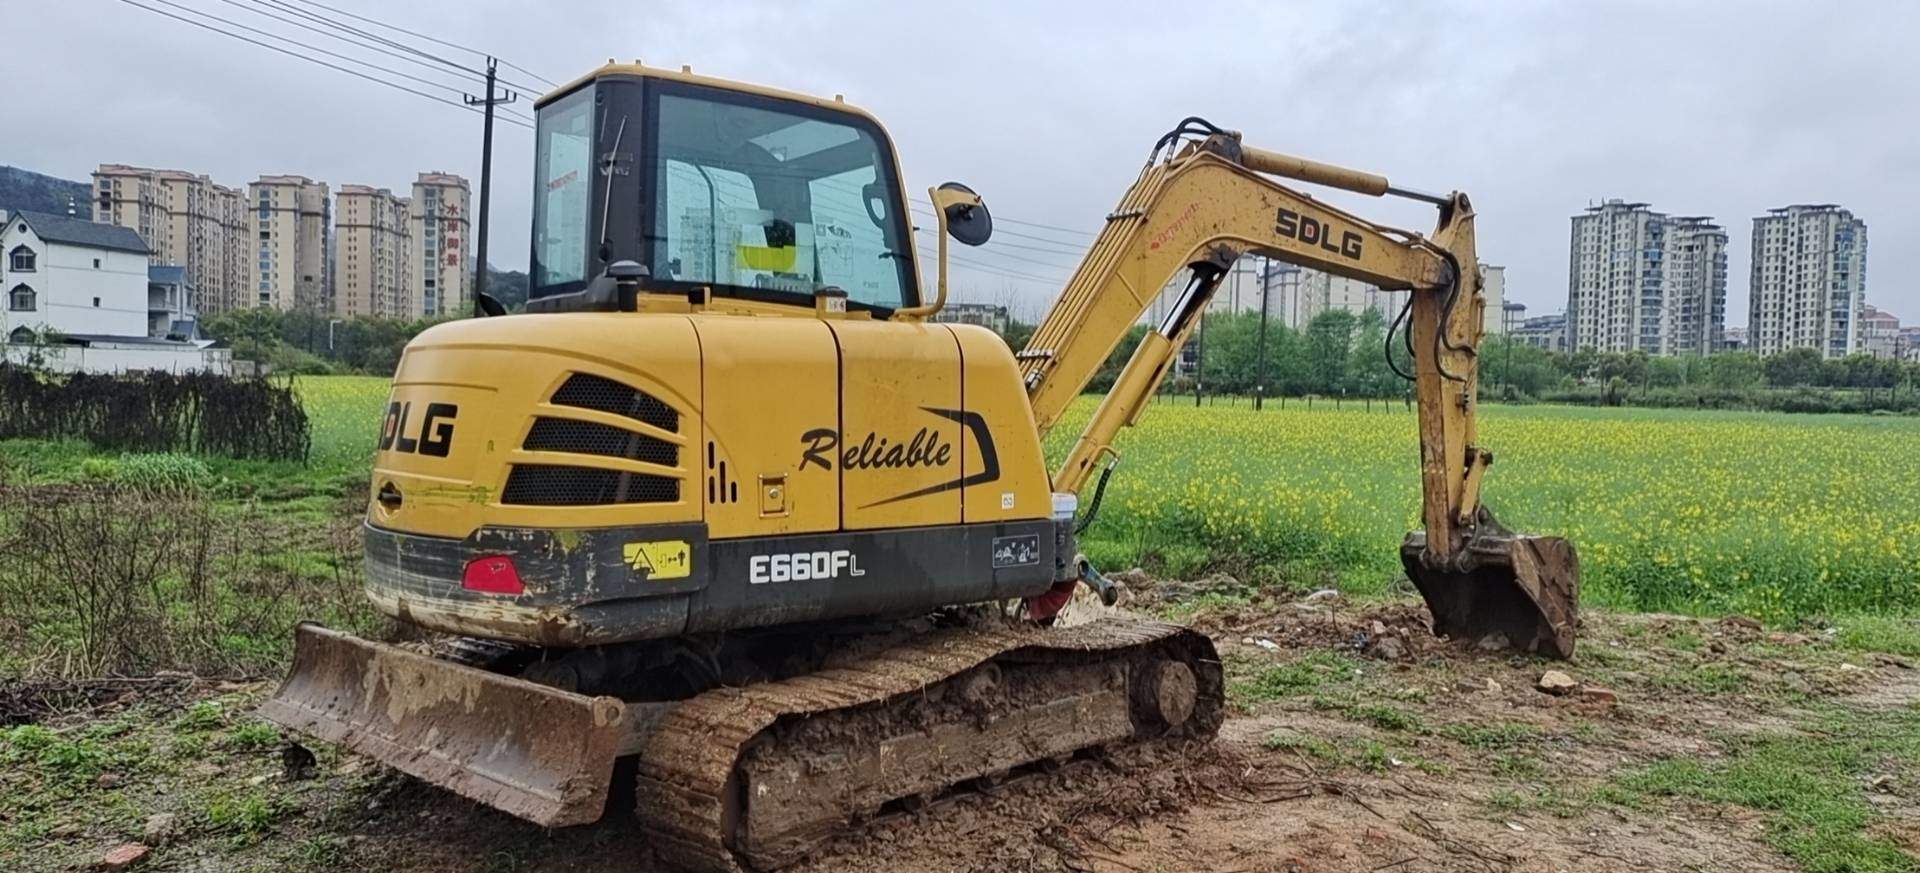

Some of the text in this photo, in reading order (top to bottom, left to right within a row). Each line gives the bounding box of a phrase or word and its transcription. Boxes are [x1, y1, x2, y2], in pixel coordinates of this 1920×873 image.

[1275, 207, 1363, 260] SDLG
[378, 401, 458, 458] DLG
[798, 427, 951, 471] Reliable
